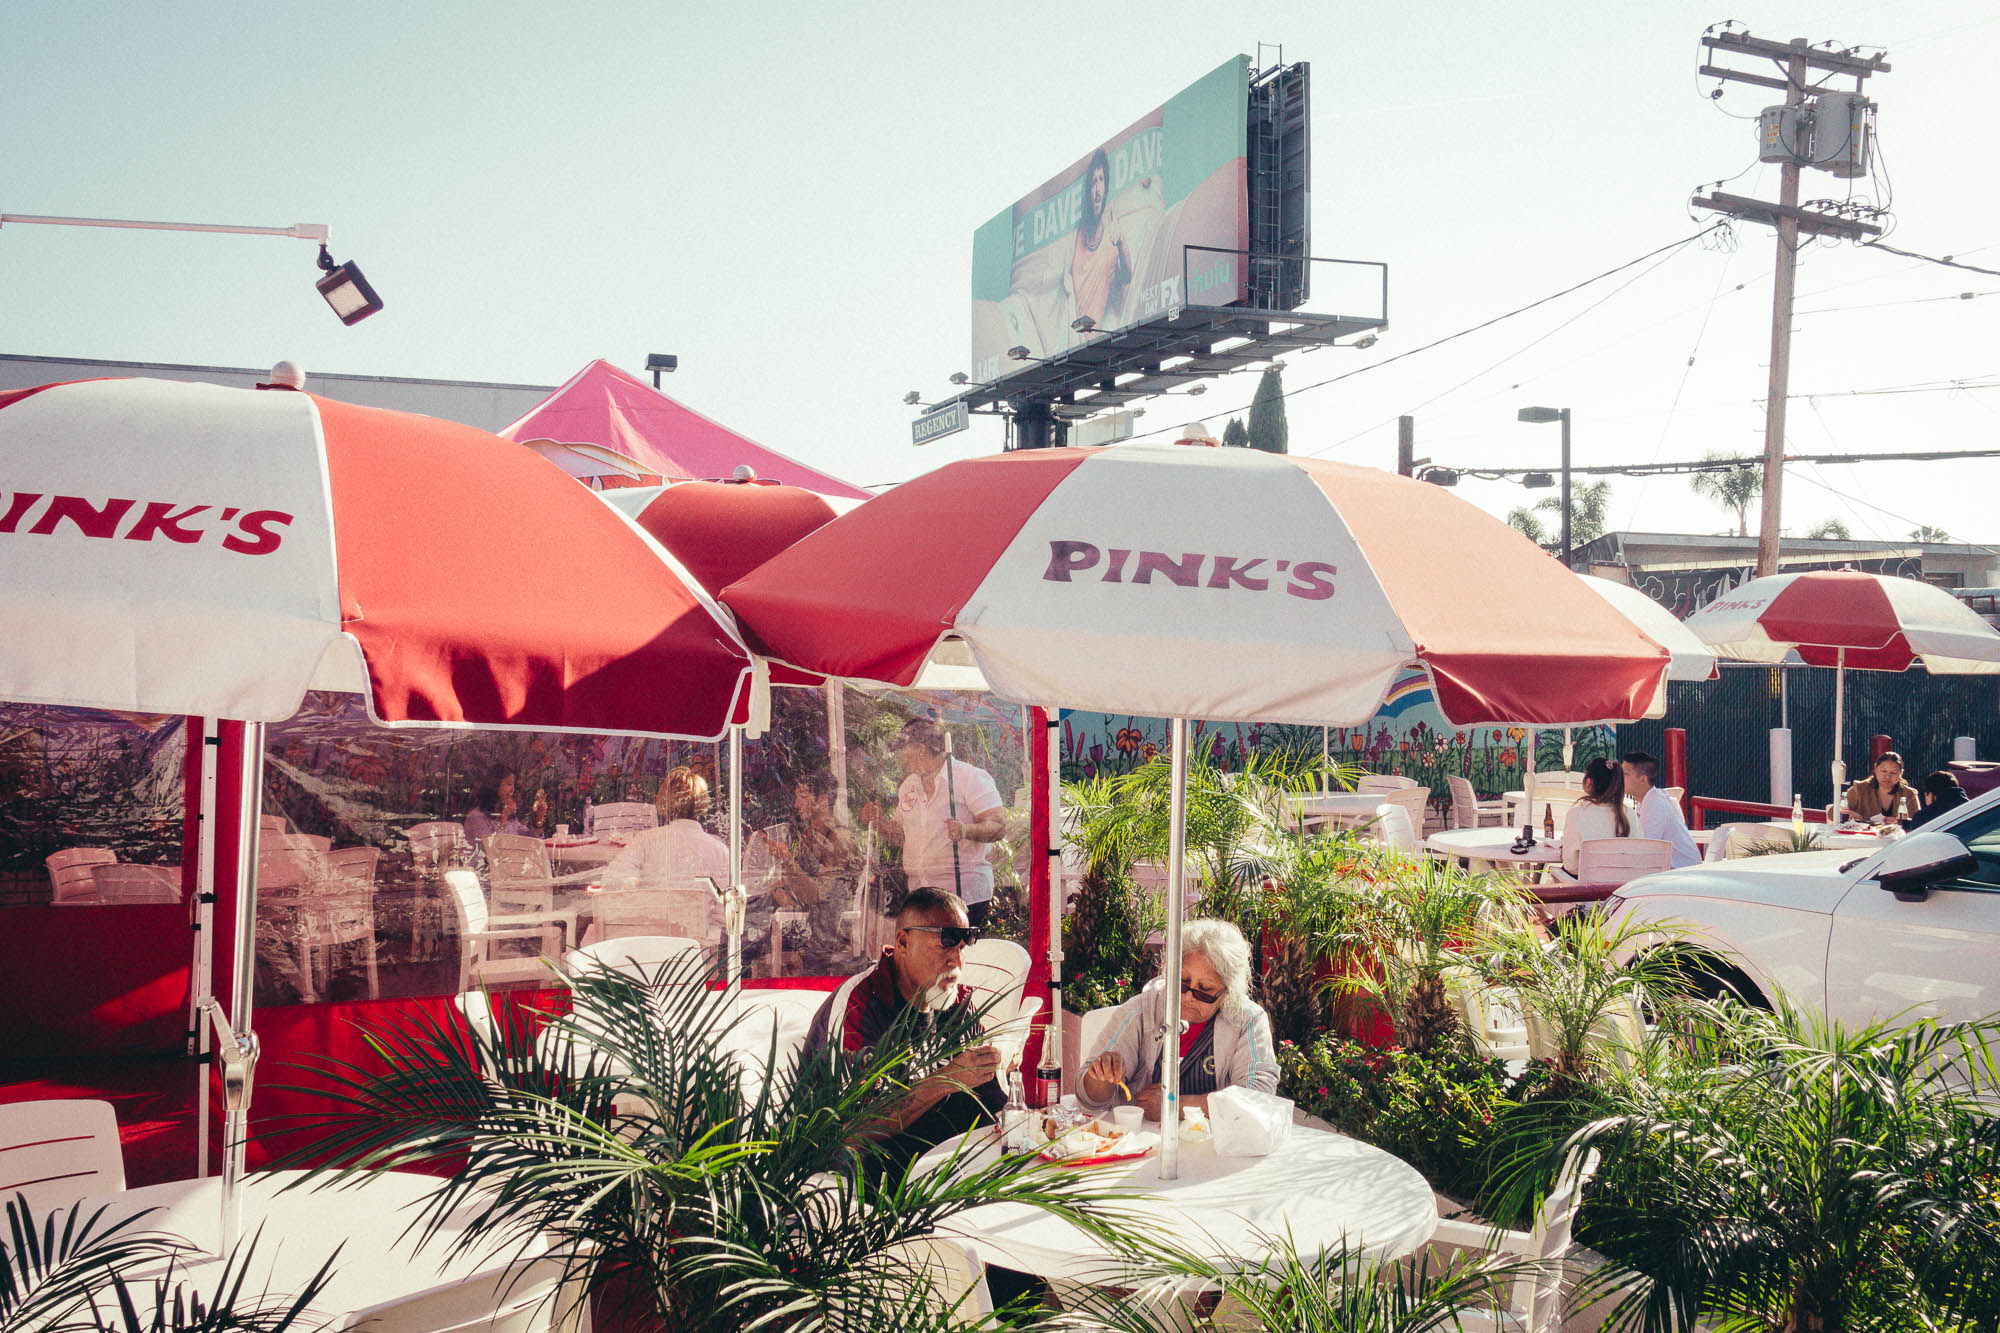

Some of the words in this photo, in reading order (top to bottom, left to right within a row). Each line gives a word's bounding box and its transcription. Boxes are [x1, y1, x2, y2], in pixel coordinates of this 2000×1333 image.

[1033, 182, 1083, 246] DAVE
[1161, 275, 1180, 308] FX
[1193, 259, 1230, 296] hulu
[915, 410, 957, 440] REGENCY
[0, 492, 294, 556] INK'S
[1042, 540, 1337, 601] PINK'S
